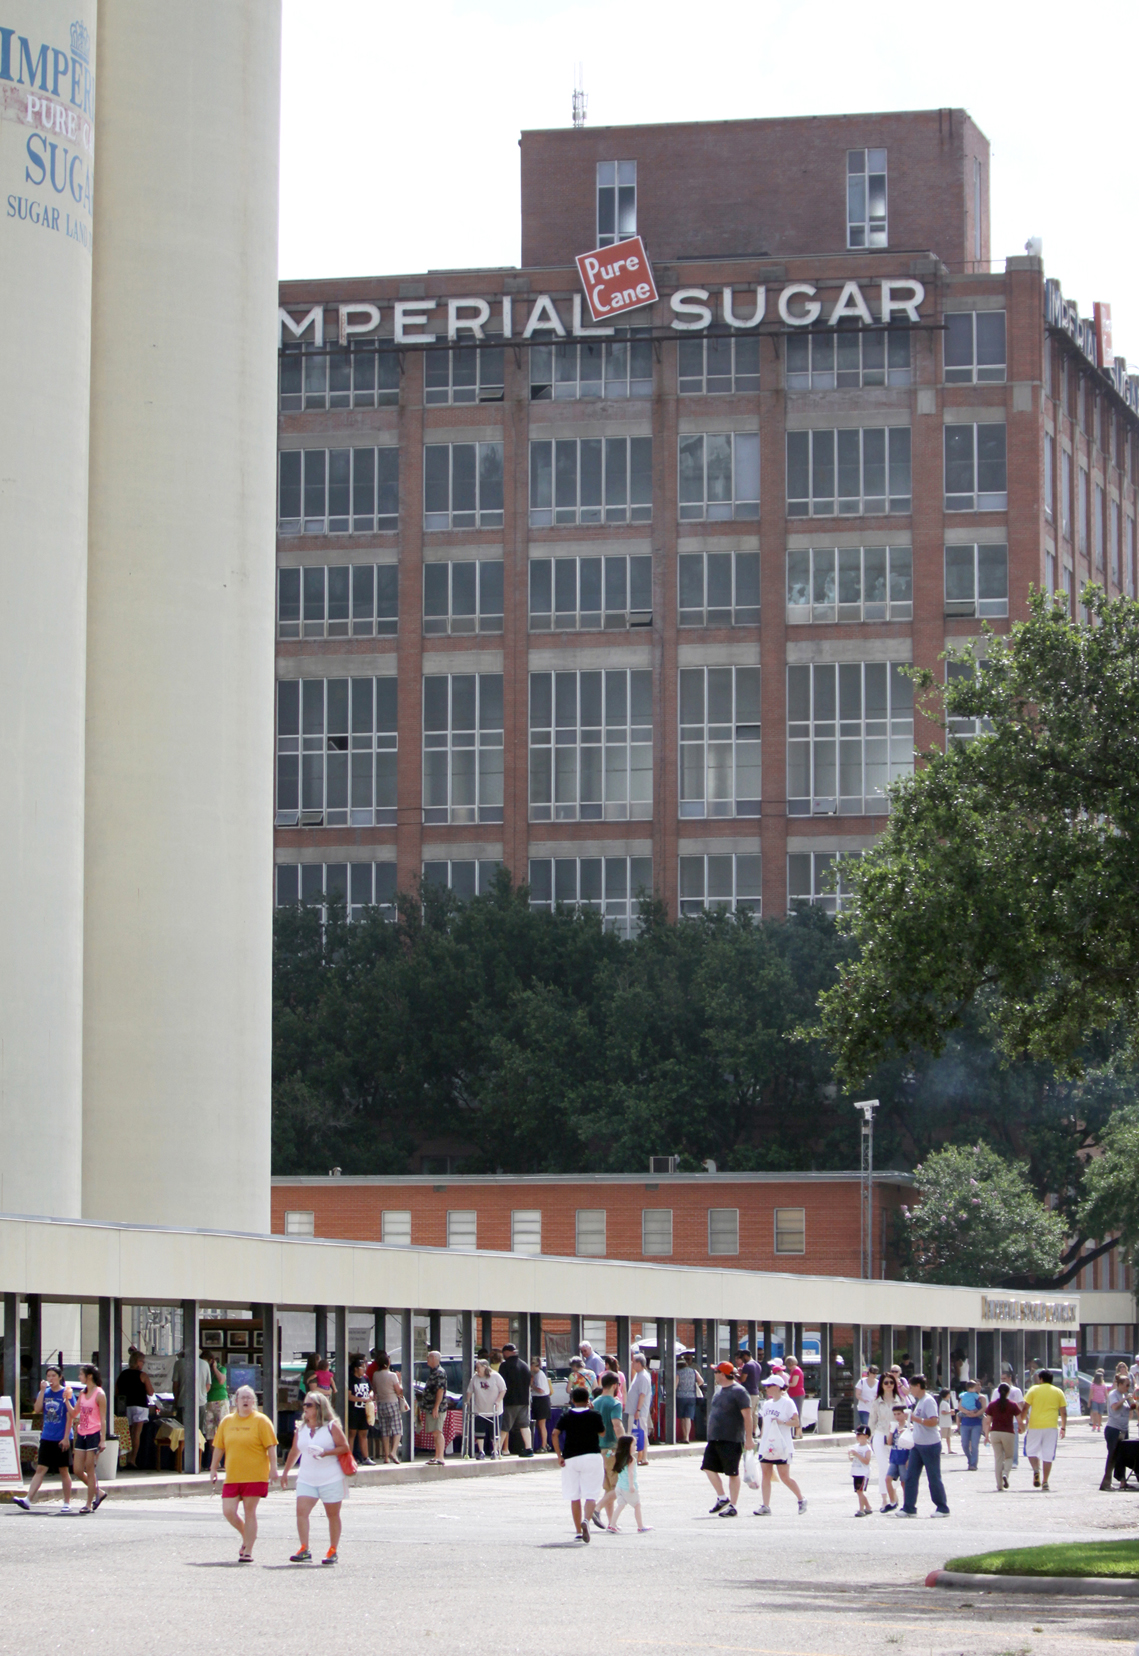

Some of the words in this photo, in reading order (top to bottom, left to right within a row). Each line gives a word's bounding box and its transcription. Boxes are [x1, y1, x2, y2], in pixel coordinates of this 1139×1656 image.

[26, 94, 77, 141] PURE
[7, 195, 60, 231] SUGAR
[66, 213, 88, 248] LAND
[584, 256, 639, 285] Pure
[593, 282, 650, 312] Cane
[670, 279, 925, 331] SUGAR
